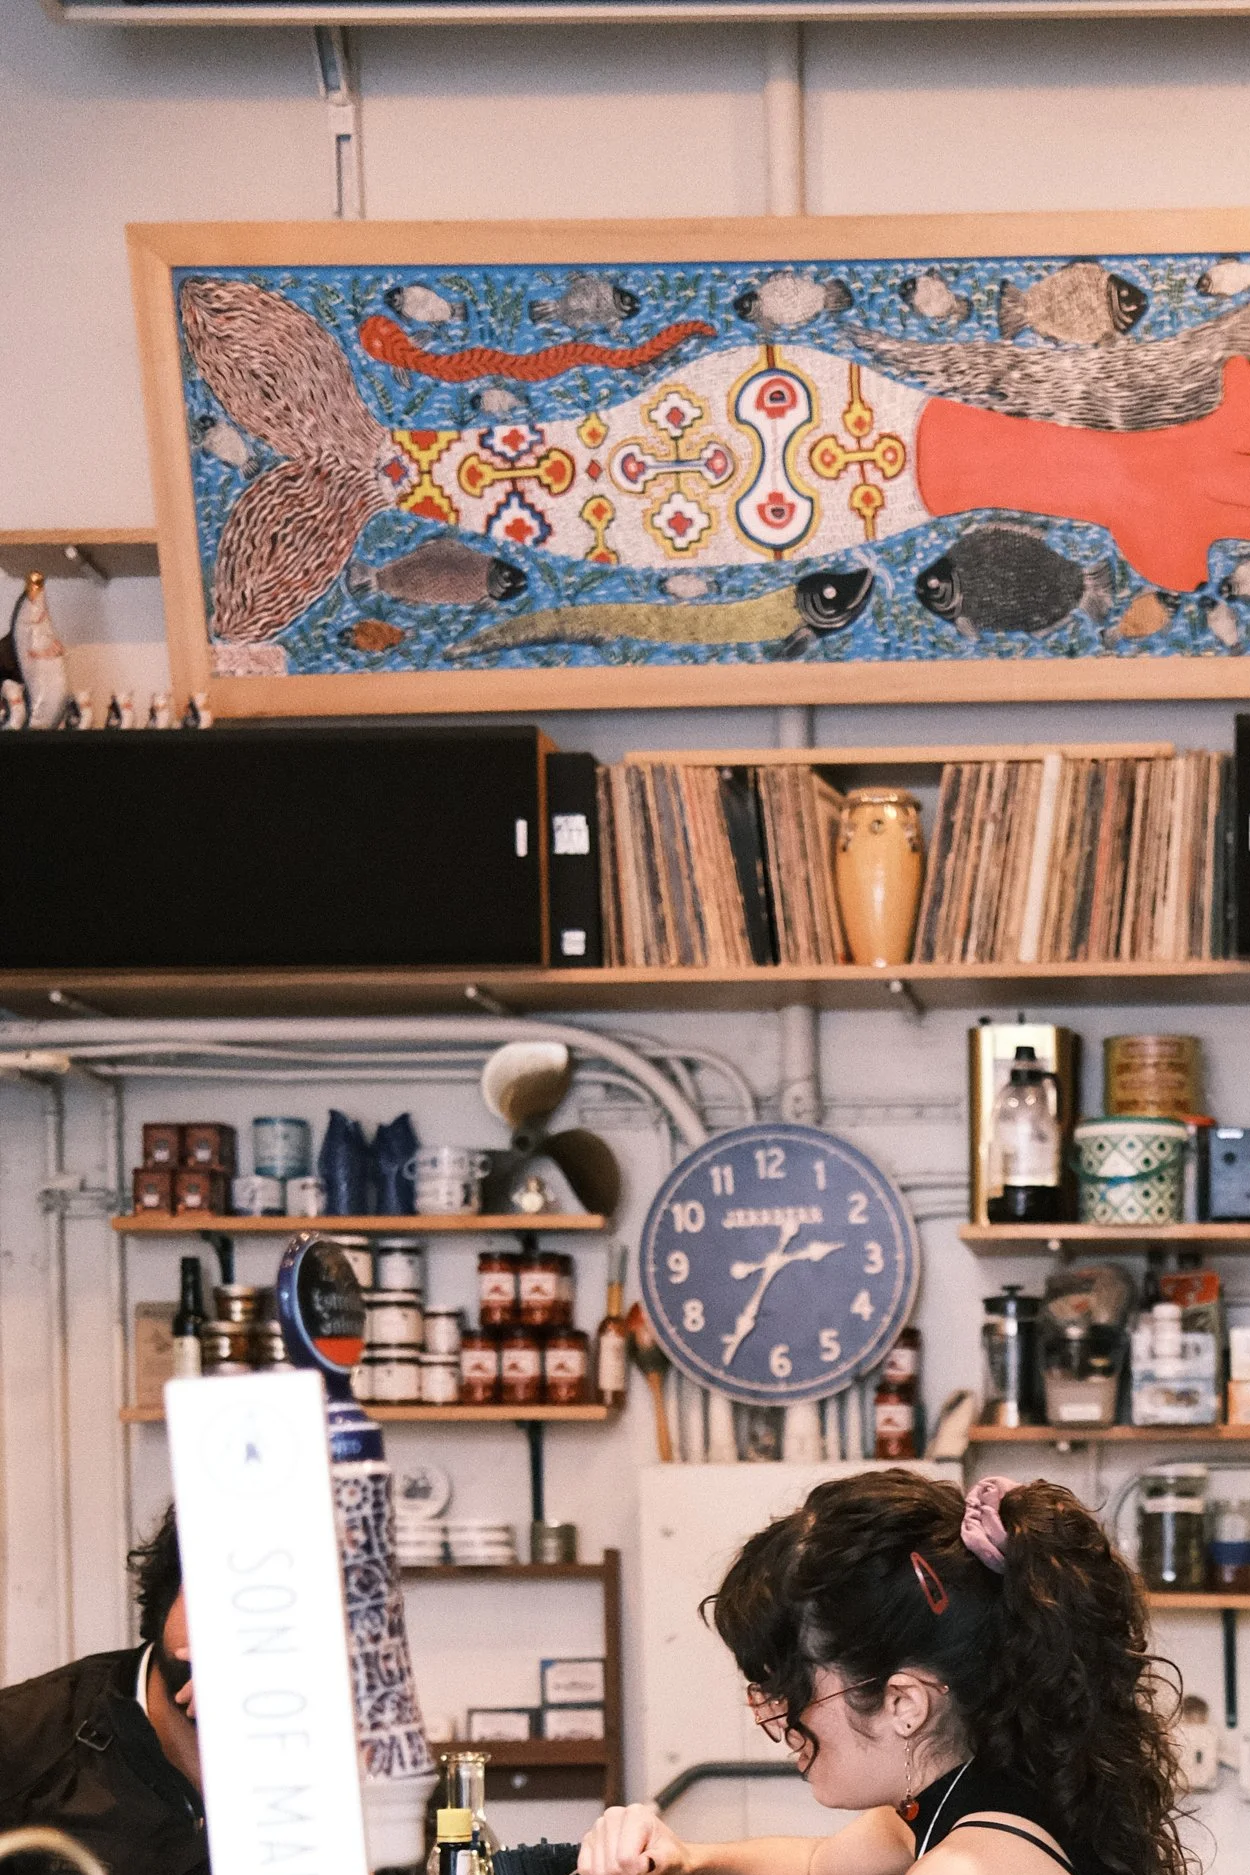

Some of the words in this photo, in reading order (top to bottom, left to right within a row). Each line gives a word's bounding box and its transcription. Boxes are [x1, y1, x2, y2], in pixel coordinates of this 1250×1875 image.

[755, 1147, 786, 1179] 12
[813, 1160, 826, 1191] 1
[710, 1165, 735, 1196] 11
[671, 1201, 705, 1233] 10
[848, 1191, 870, 1224] 2
[667, 1251, 690, 1284] 9
[864, 1241, 884, 1274] 3
[682, 1298, 706, 1332] 8
[851, 1288, 875, 1321] 4
[768, 1344, 793, 1377] 6
[818, 1328, 841, 1362] 5
[226, 1547, 298, 1656] SON
[240, 1687, 312, 1756] OF
